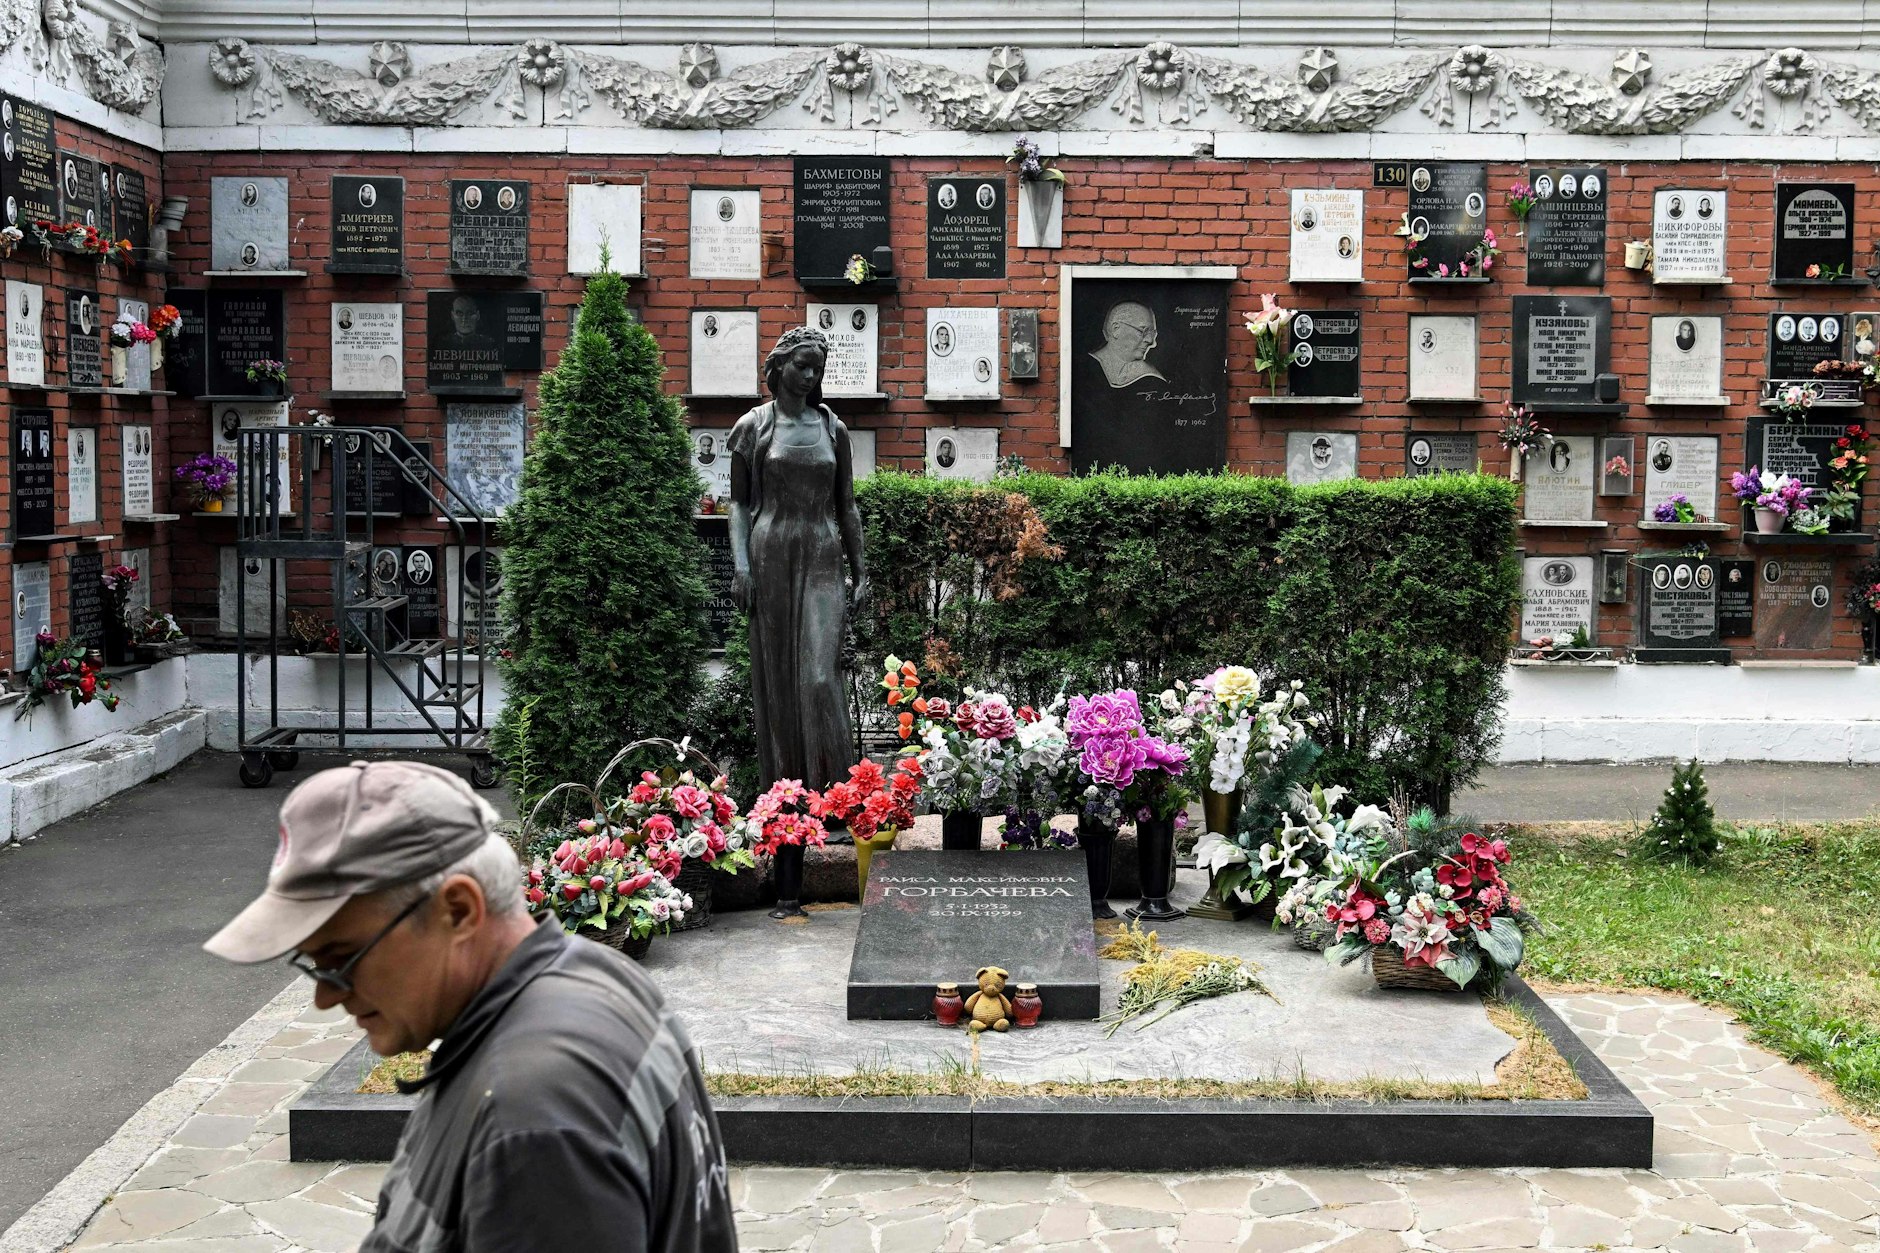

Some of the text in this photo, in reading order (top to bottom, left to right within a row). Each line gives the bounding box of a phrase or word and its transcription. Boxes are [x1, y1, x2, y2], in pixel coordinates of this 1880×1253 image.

[804, 169, 882, 179] БАХМЕТОВЫ
[1377, 168, 1405, 182] 130
[1794, 200, 1838, 209] МАМАЕВЫ
[340, 214, 394, 224] ДМИТРИЕВ
[943, 214, 989, 225] ДОЗОРЕЦ
[359, 225, 398, 233] ПЕТРОВИЧ
[1658, 223, 1722, 231] НИКИФОРОВЫ
[1554, 229, 1604, 237] АЛЕКСЕЕВИЧ
[1529, 252, 1555, 260] ЮРИЙ
[938, 311, 988, 319] ЛИХАЧЕВЫ
[1314, 319, 1346, 327] ПЕТРОСЯН
[1535, 319, 1590, 328] КУЗЯКОВЫ
[15, 322, 36, 337] ВАЛЬЦ
[507, 323, 540, 333] ЛЕВИЦКАЯ
[828, 333, 855, 341] МОХОВ
[433, 349, 499, 361] ЛЕВИЦКИЙ
[471, 373, 488, 381] 1969
[1768, 425, 1843, 436] БЕРЕЗКИНЫ
[1660, 481, 1702, 489] ГЛИДЕР
[1526, 589, 1588, 597] САХНОВСКИЕ
[882, 887, 1076, 897] ГОРБАЧЕВА
